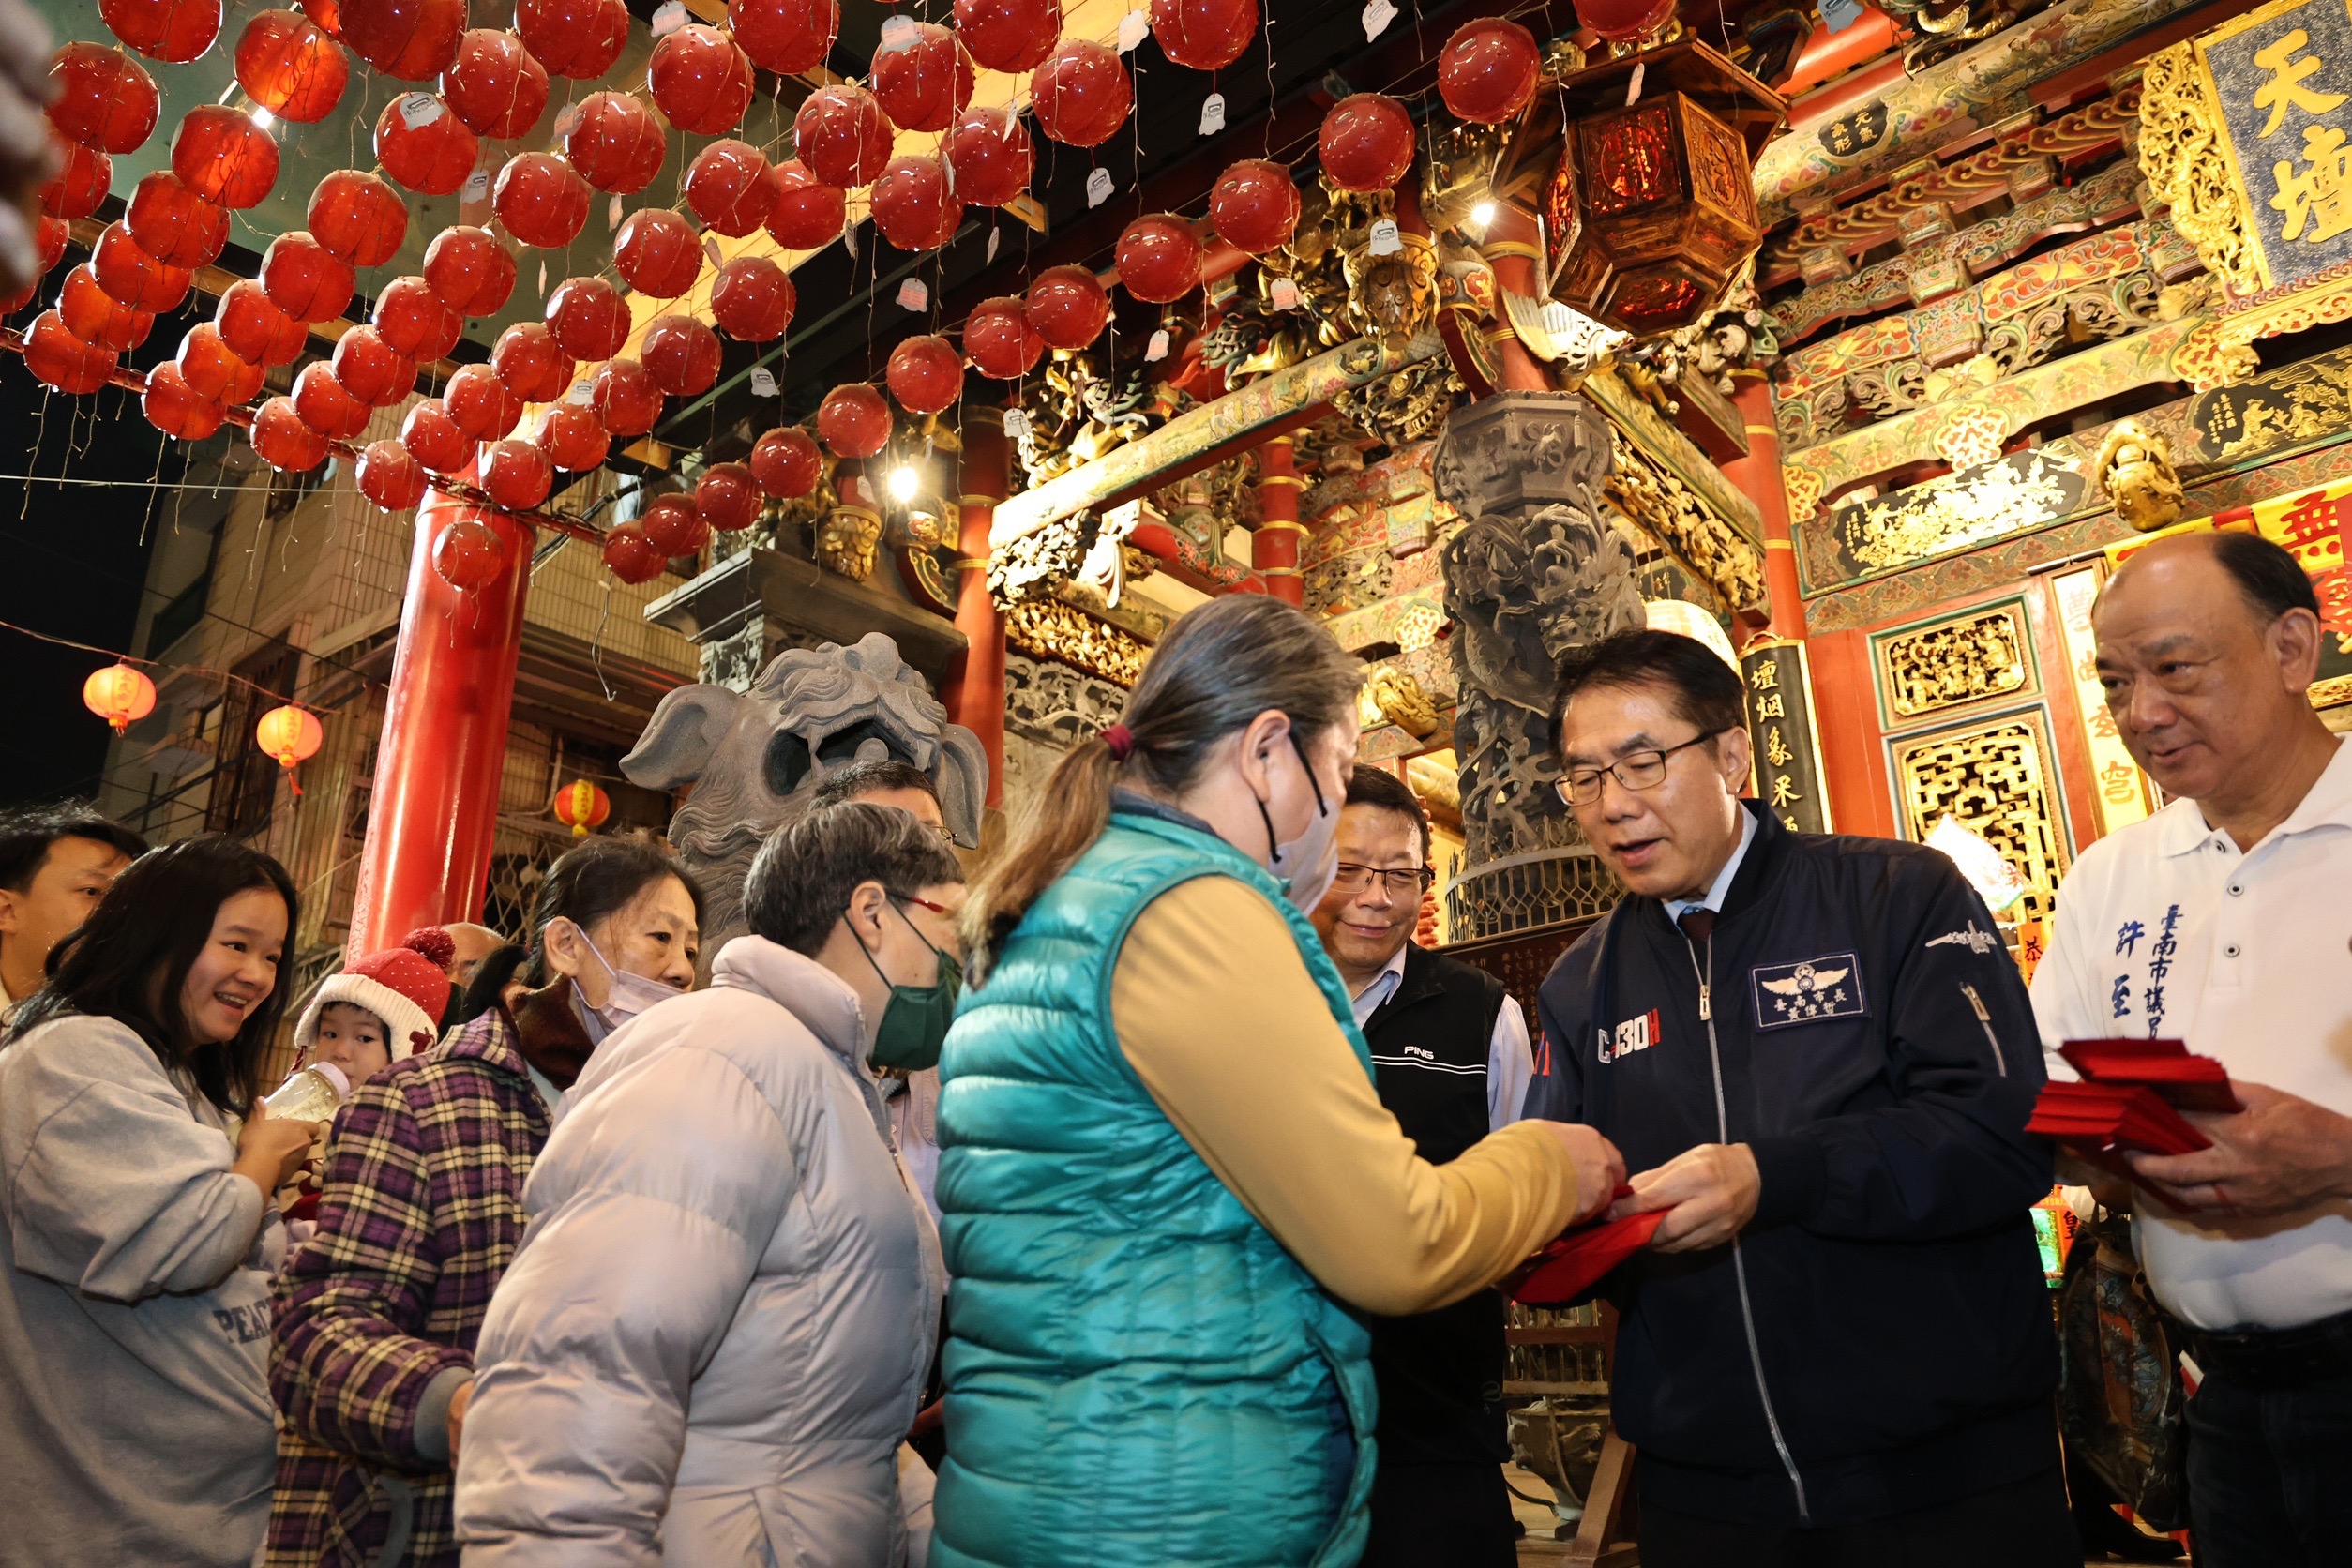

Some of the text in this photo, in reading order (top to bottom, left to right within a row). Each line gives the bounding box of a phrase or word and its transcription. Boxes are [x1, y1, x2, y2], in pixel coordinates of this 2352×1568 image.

[2254, 28, 2352, 243] 天壇
[2111, 920, 2146, 1039] 許至
[1404, 1046, 1435, 1060] PING
[1598, 1007, 1661, 1064] C-130H
